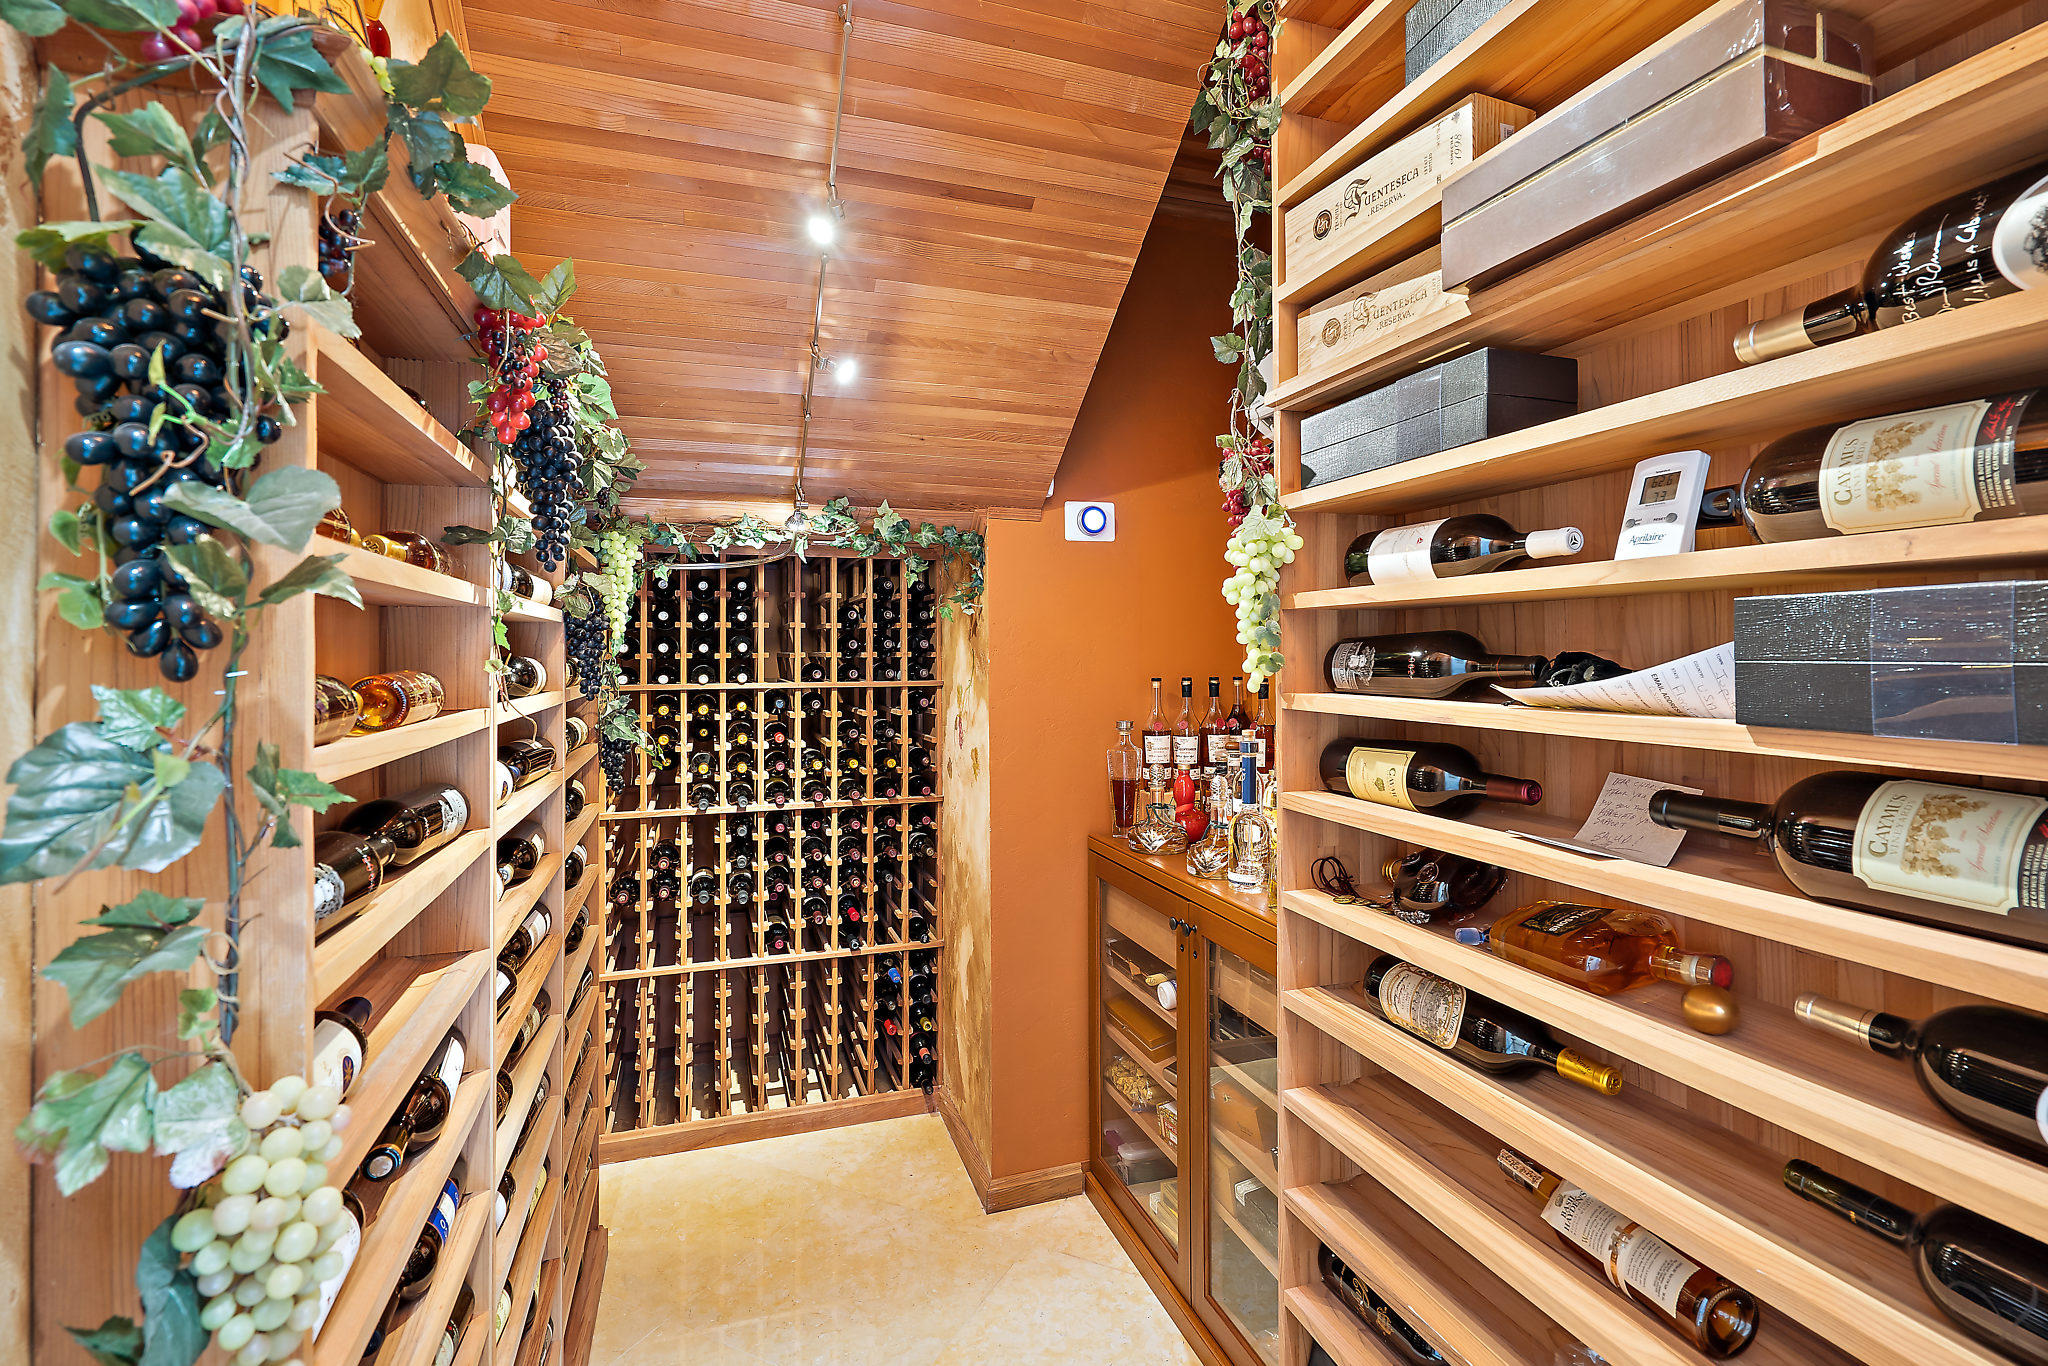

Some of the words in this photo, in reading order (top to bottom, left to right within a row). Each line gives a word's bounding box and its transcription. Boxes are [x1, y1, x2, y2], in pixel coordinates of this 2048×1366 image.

[1344, 167, 1419, 227] FUENTESECA
[1834, 438, 1858, 505] CAYMUS
[1629, 533, 1664, 545] Aprilaire
[1651, 673, 1665, 691] EMAIL
[1868, 794, 1907, 858] CAYMUS
[1560, 1195, 1576, 1218] BASIL
[1563, 1190, 1588, 1231] HAYDEN'S
